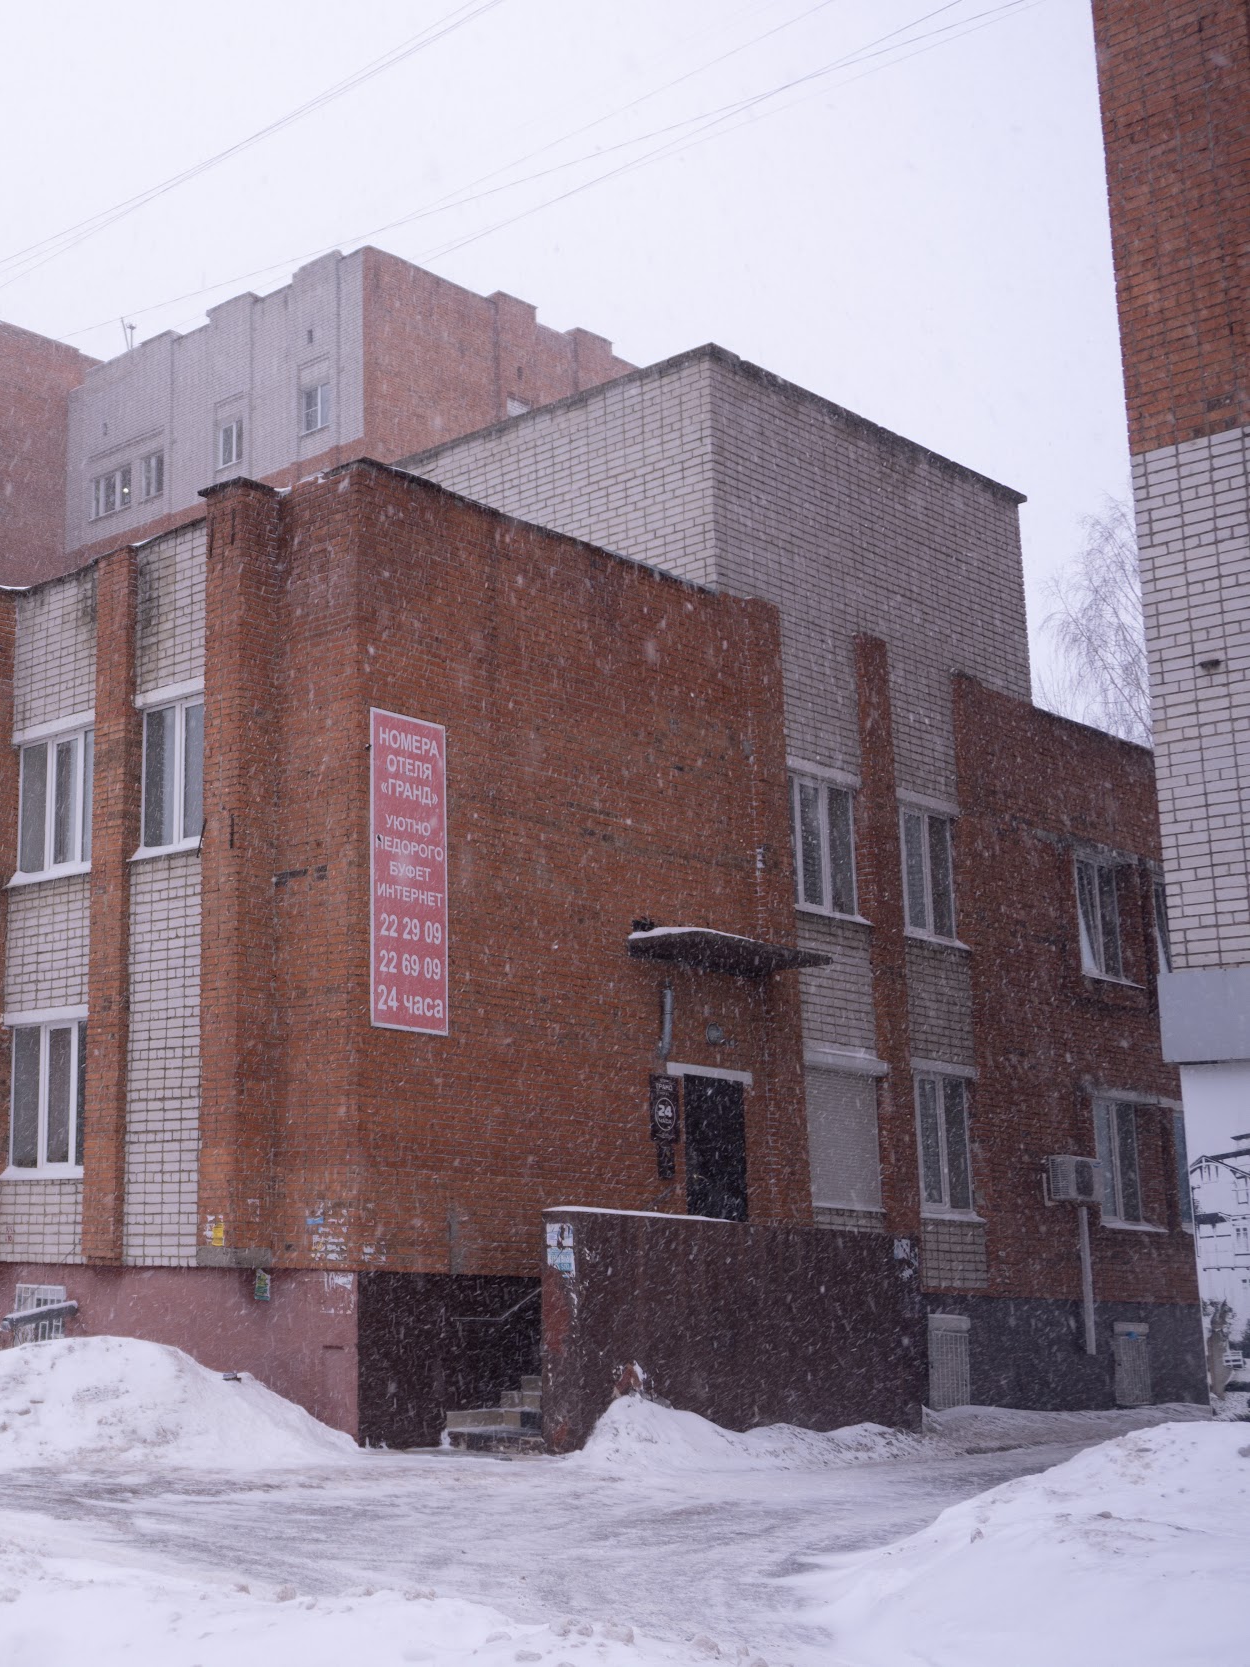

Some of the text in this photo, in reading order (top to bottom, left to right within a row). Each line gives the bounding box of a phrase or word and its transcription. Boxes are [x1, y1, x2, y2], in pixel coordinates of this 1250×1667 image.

[379, 726, 440, 758] НОМЕРА
[386, 754, 432, 781] ОТЕЛЯ
[380, 778, 439, 807] «ГРАНД»
[385, 814, 431, 836] УЮТНО
[375, 834, 444, 862] НЕДОРОГО
[389, 861, 431, 882] БУФЕТ
[377, 882, 443, 907] ИНТЕРНЕТ
[380, 912, 442, 945] 22 29 09
[379, 949, 441, 980] 22 69 09
[377, 984, 444, 1019] 24 часа
[658, 1104, 672, 1118] 24
